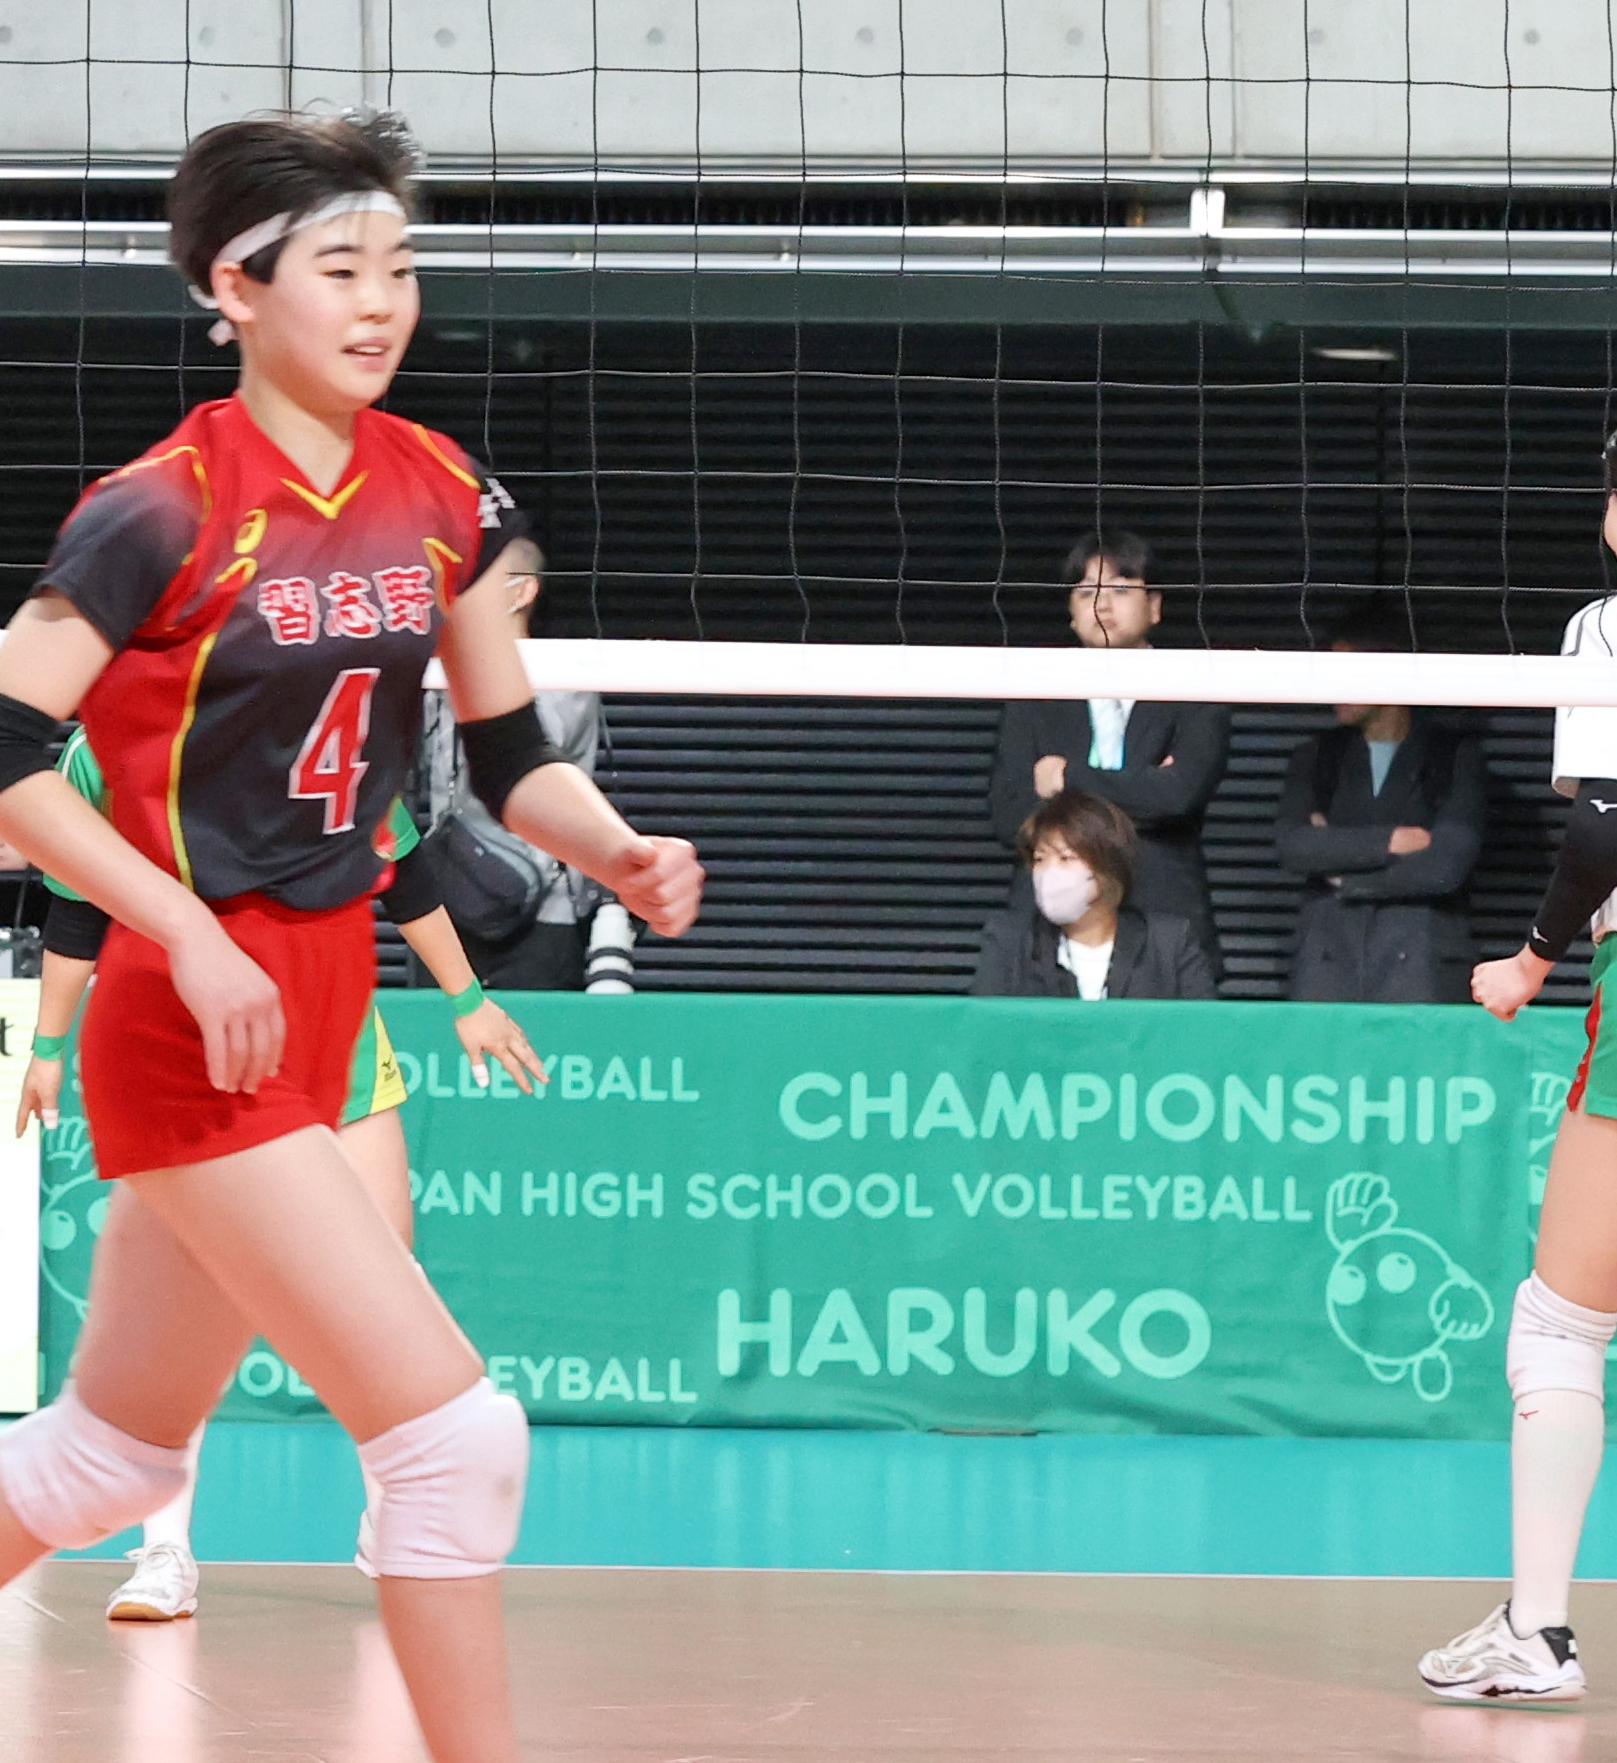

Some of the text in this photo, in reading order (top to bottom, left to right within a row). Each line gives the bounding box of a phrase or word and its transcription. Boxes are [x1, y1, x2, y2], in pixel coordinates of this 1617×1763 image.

[258, 565, 435, 646] 習志野
[288, 666, 382, 836] 4
[778, 1070, 1497, 1145] CHAMPIONSHIP
[521, 1171, 664, 1219] HIGH
[686, 1172, 934, 1220] SCHOOL
[952, 1173, 1314, 1222] VOLLEYBALL
[717, 1286, 1212, 1379] HARUKO
